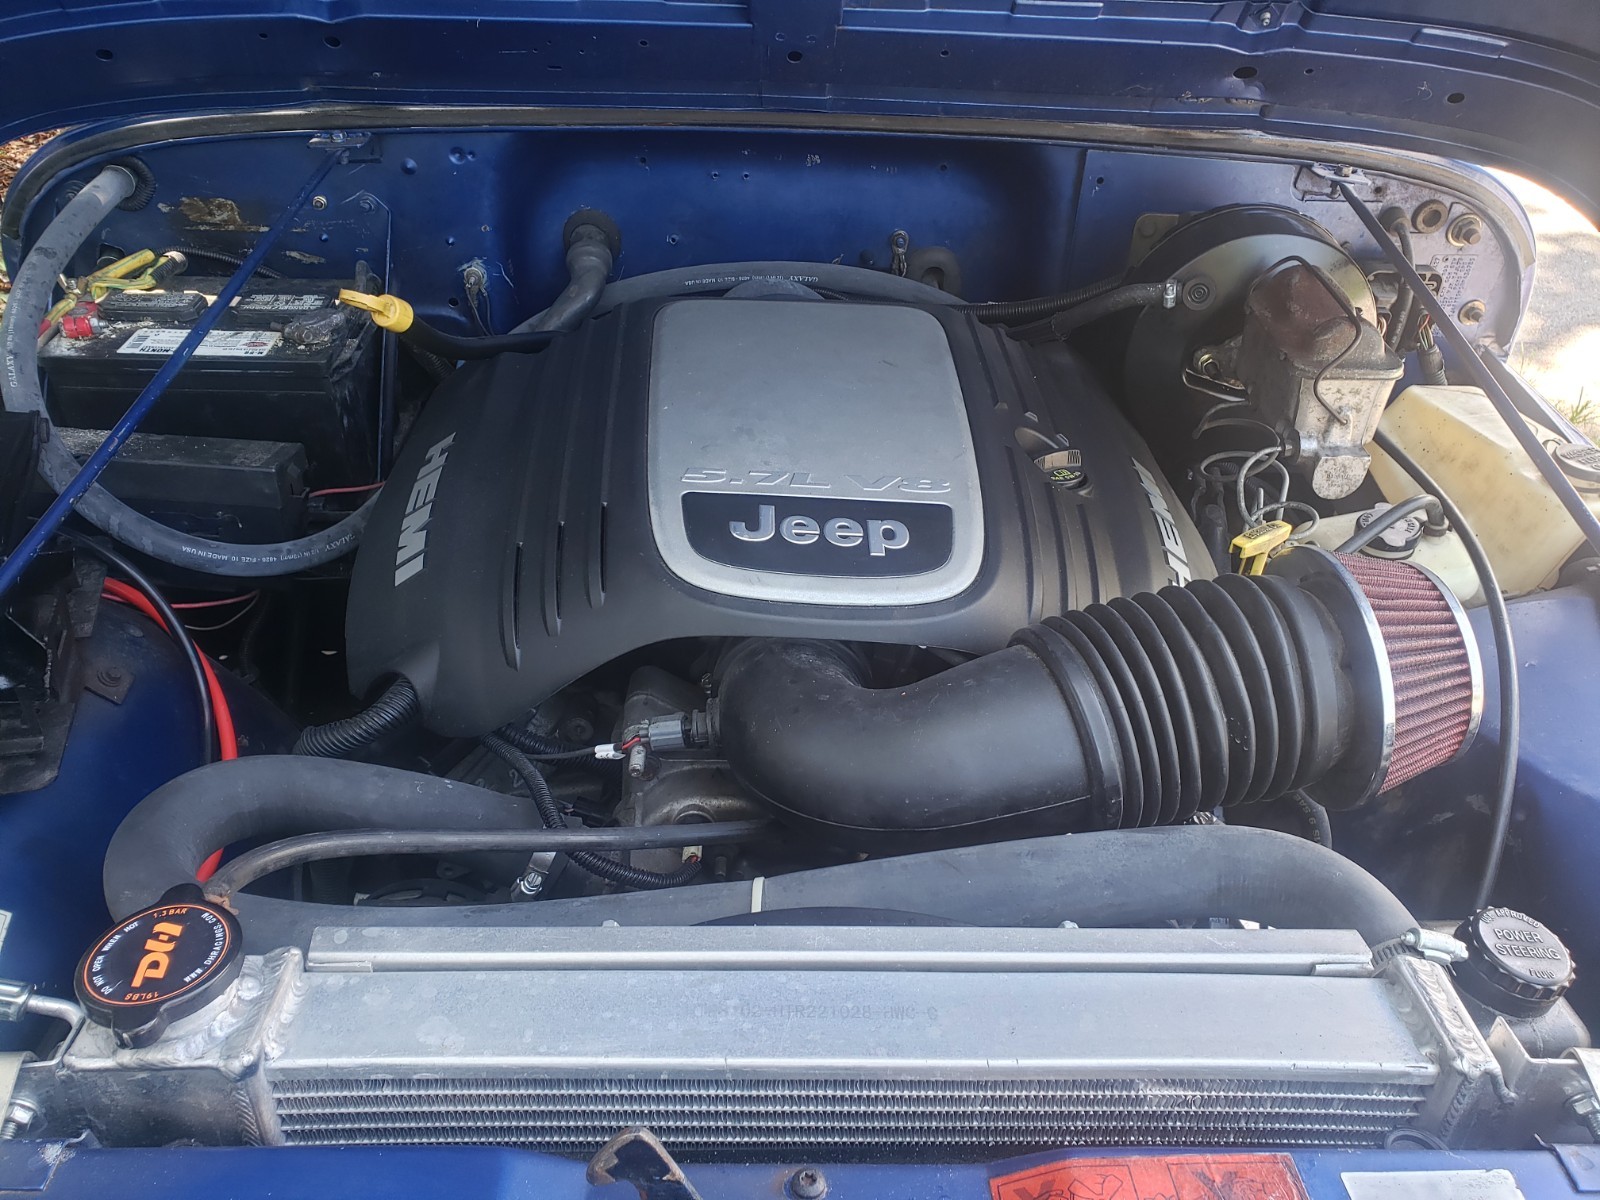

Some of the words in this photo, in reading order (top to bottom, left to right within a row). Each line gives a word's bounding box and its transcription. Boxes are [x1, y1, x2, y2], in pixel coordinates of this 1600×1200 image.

[6, 355, 18, 387] GALAXY
[680, 467, 831, 489] 5.7L
[846, 474, 951, 493] V8
[395, 432, 456, 587] HEMI
[729, 504, 910, 556] Jeep
[181, 545, 197, 555] USA
[207, 551, 229, 561] MADE
[1495, 908, 1540, 928] APPROVED
[124, 921, 139, 933] HOT
[1494, 927, 1544, 943] POWER
[101, 934, 121, 952] WHEN
[1494, 943, 1561, 960] STEERING
[92, 955, 105, 972] OPEN
[92, 975, 105, 988] NOT
[1529, 968, 1556, 979] FLUID
[125, 993, 160, 1001] 19LBS
